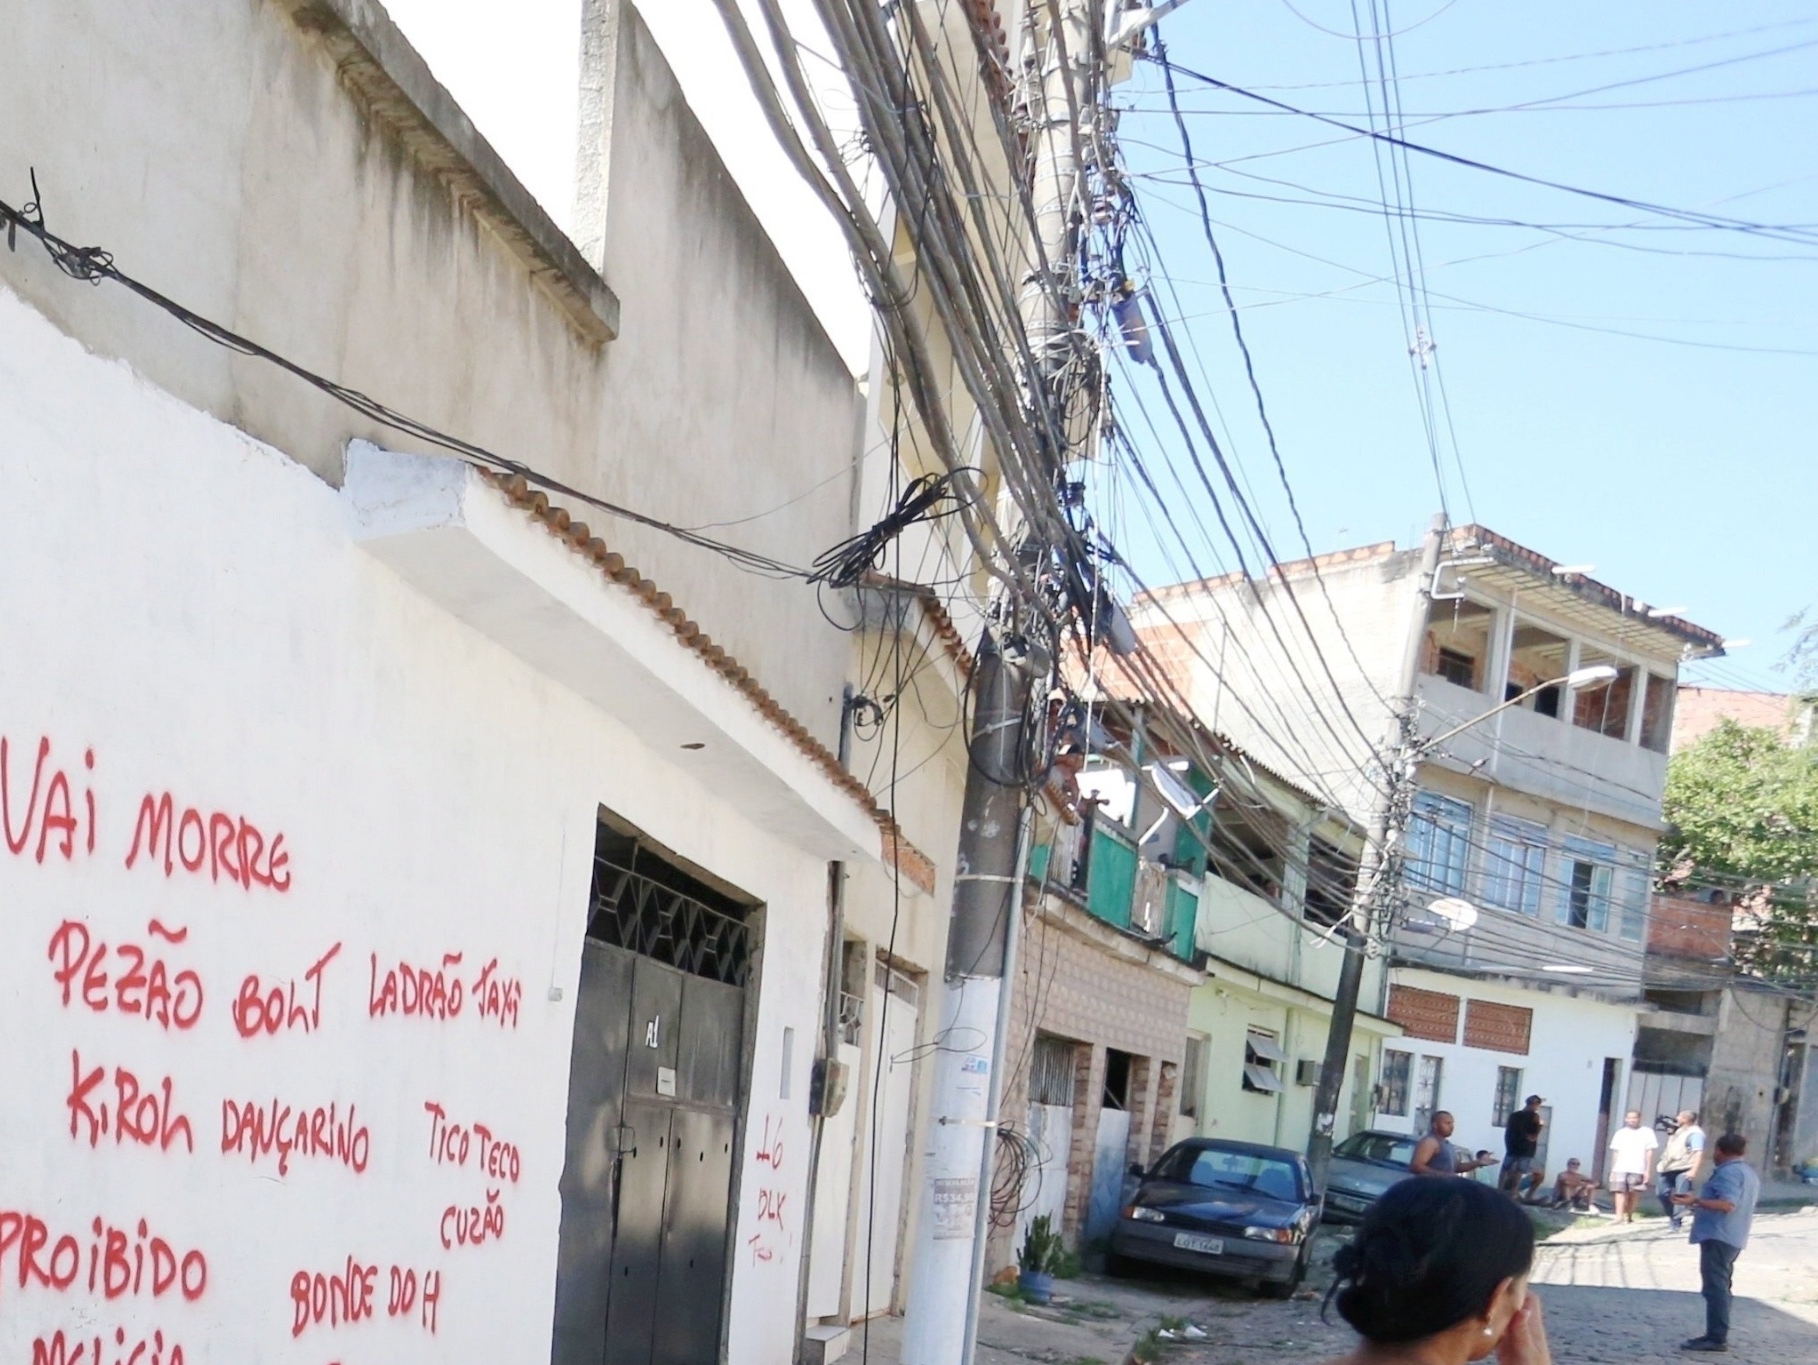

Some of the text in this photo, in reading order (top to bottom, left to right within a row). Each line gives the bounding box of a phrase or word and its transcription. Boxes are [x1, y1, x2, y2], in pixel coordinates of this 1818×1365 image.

[125, 792, 292, 893] MORRE
[48, 918, 204, 1030] PEZÃO
[232, 942, 342, 1038] BOLT
[369, 952, 464, 1020] LADRÃO
[221, 1099, 370, 1176] DANÇARINO
[289, 1254, 379, 1339] BONDE
[387, 1265, 418, 1317] DO
